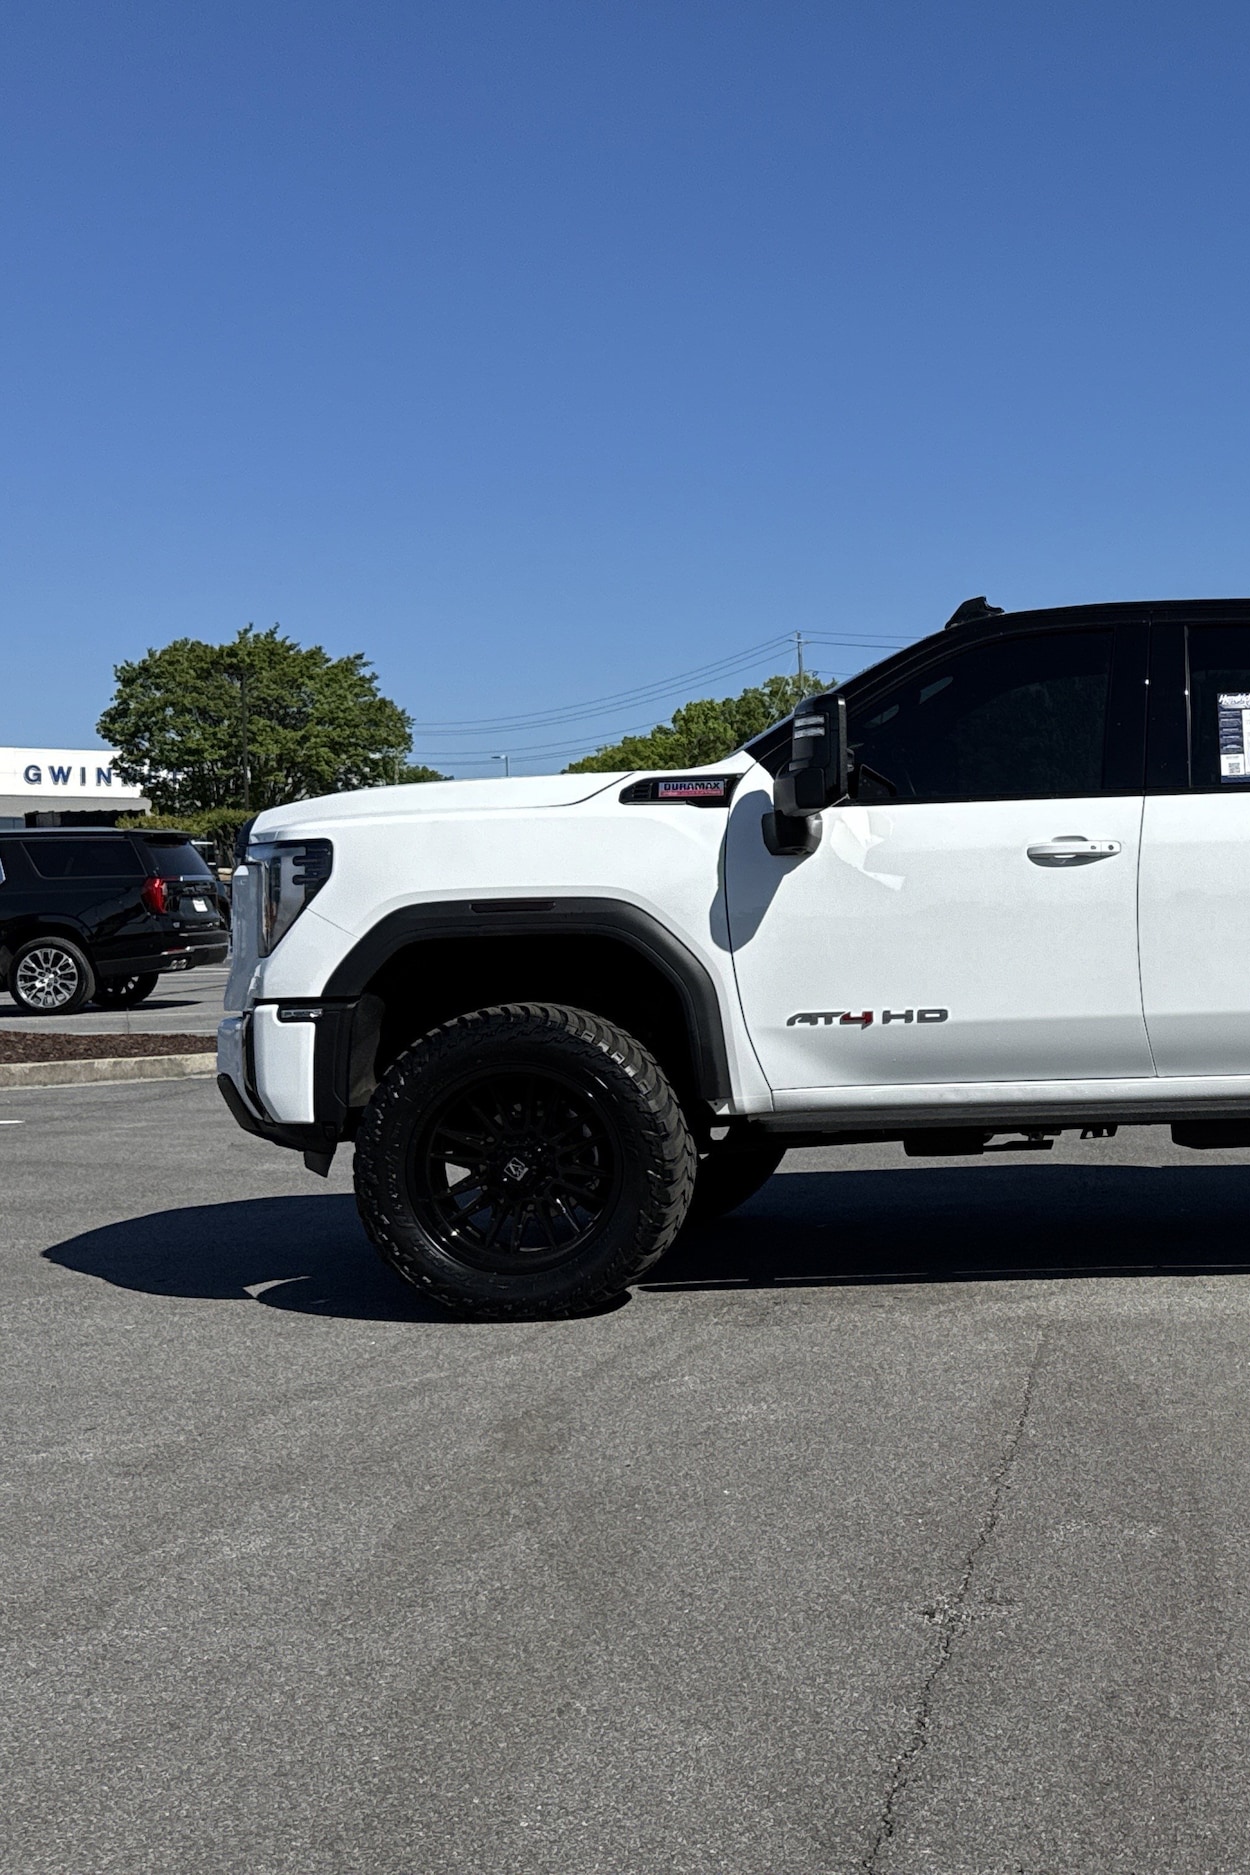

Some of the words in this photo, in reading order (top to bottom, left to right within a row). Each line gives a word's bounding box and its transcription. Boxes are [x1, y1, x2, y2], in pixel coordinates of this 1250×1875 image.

[663, 782, 720, 791] DURAMAX
[786, 1010, 874, 1030] AT4
[882, 1008, 949, 1024] HD
